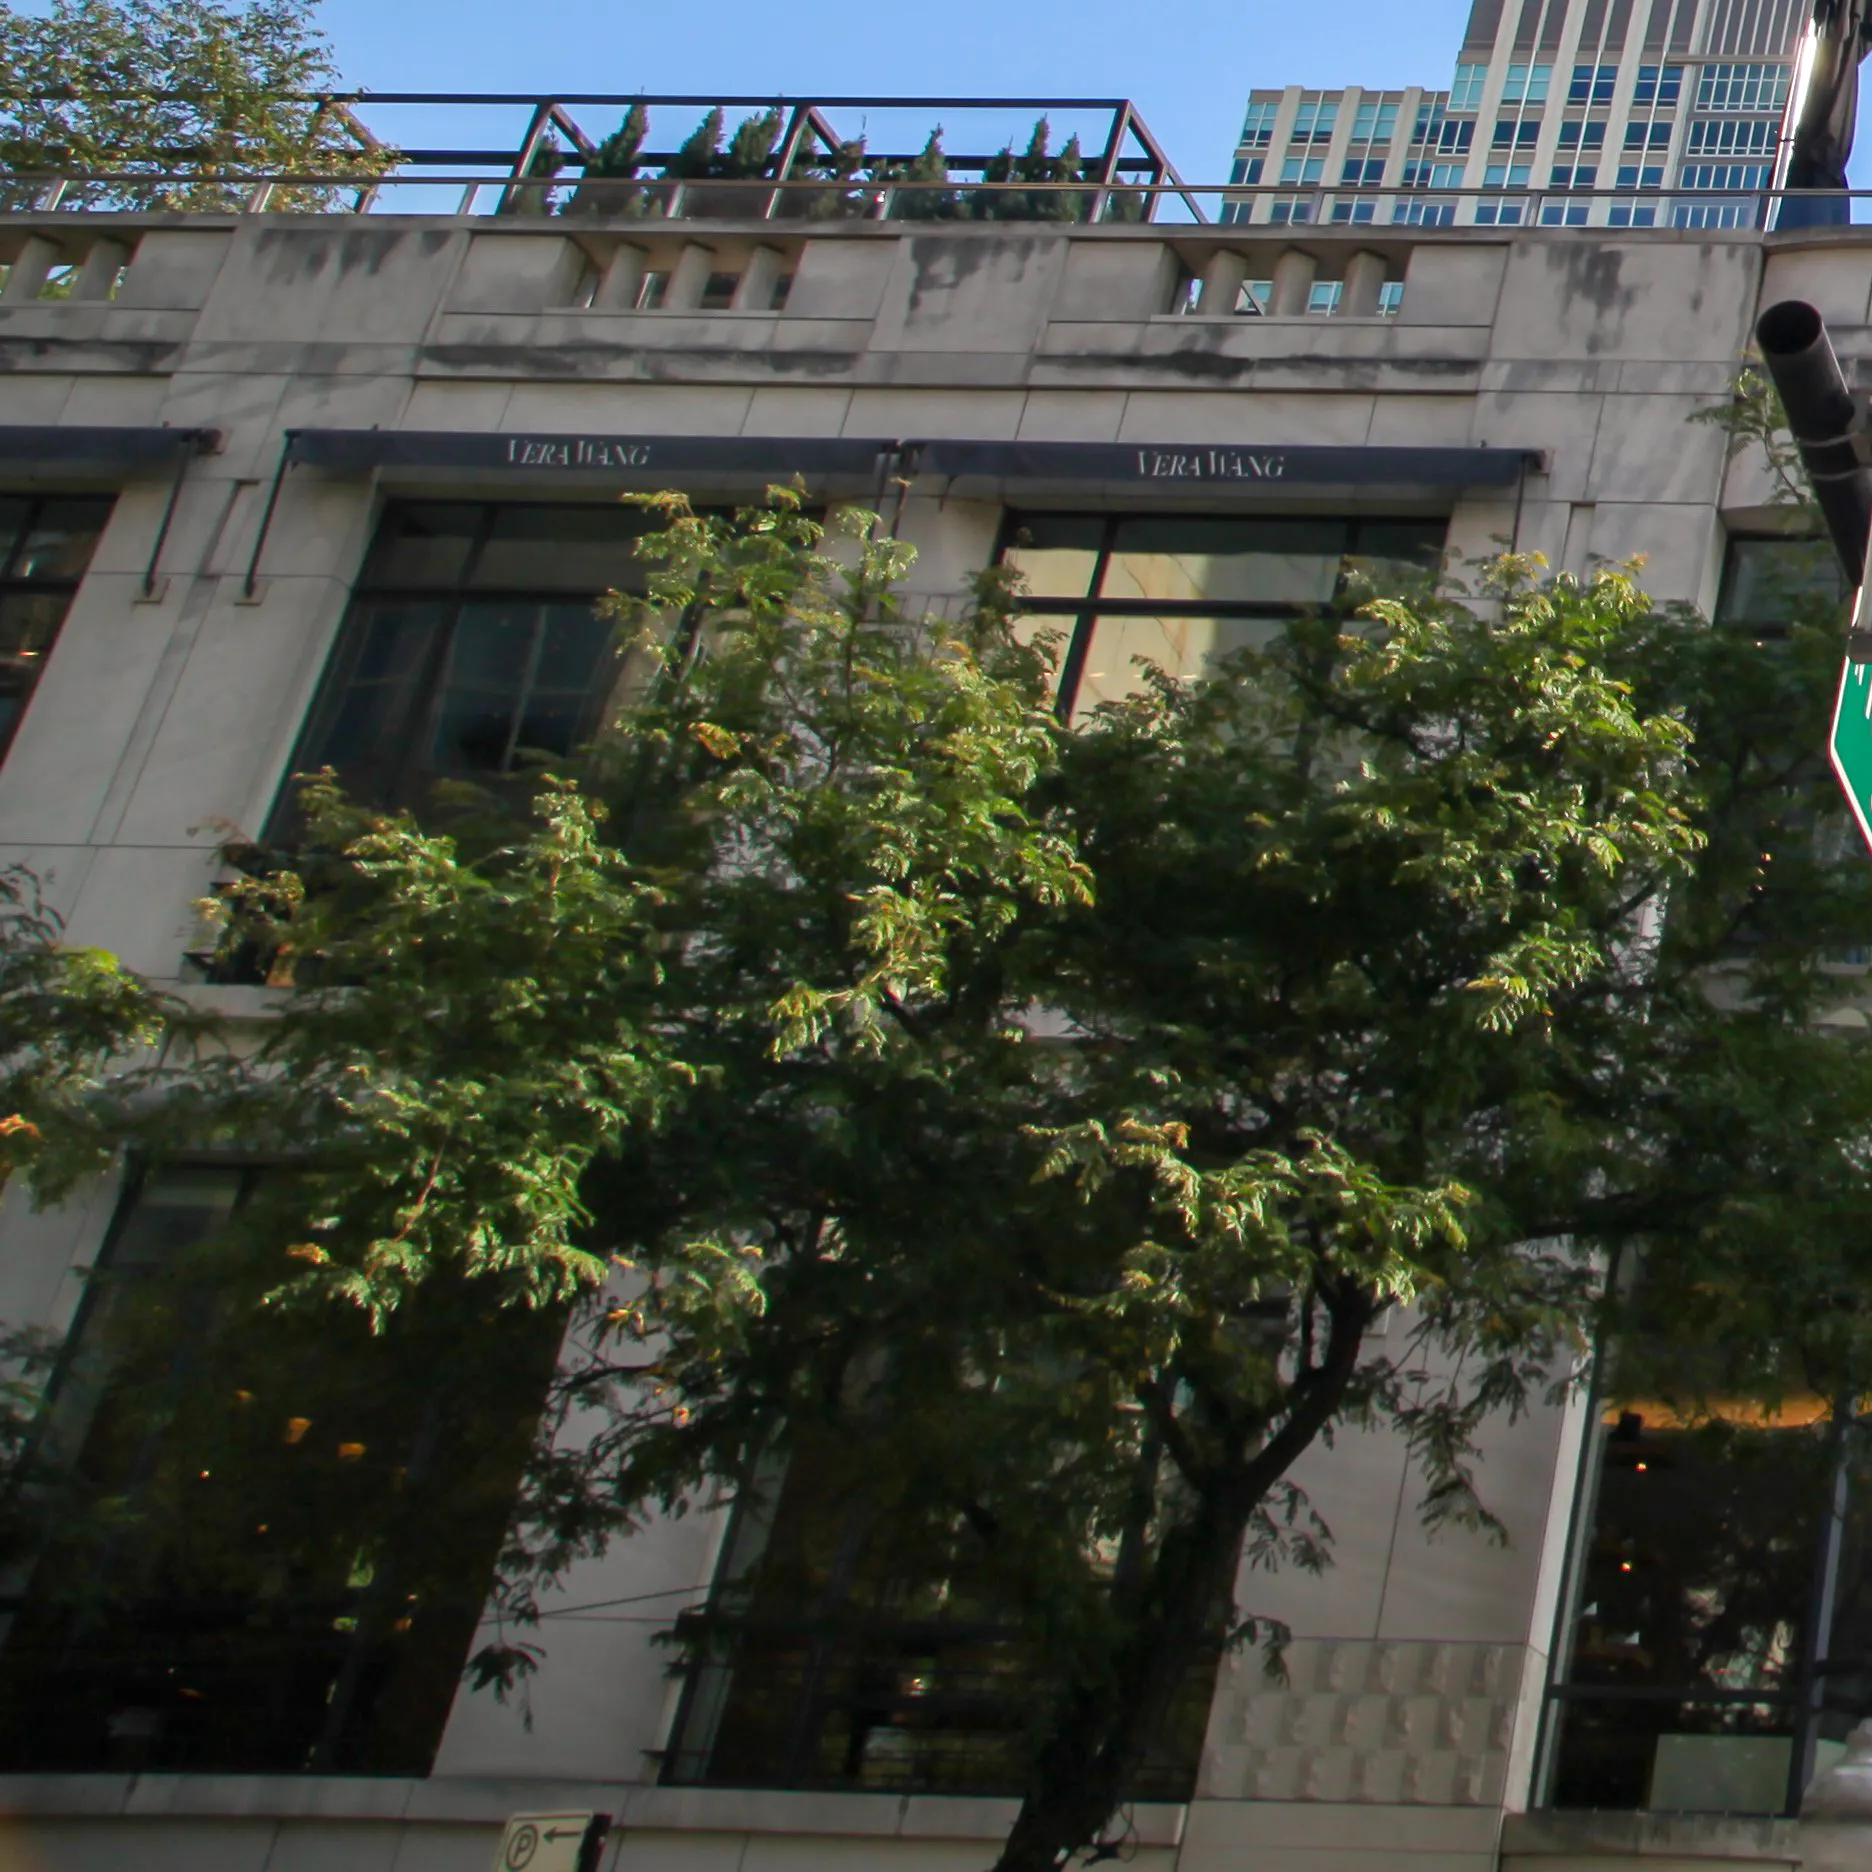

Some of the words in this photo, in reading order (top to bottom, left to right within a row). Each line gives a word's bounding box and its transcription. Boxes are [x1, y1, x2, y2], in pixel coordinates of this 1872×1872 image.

[508, 438, 570, 466] VERA
[575, 439, 651, 466] WANG
[1137, 450, 1201, 478] VERA
[1208, 450, 1285, 478] WANG
